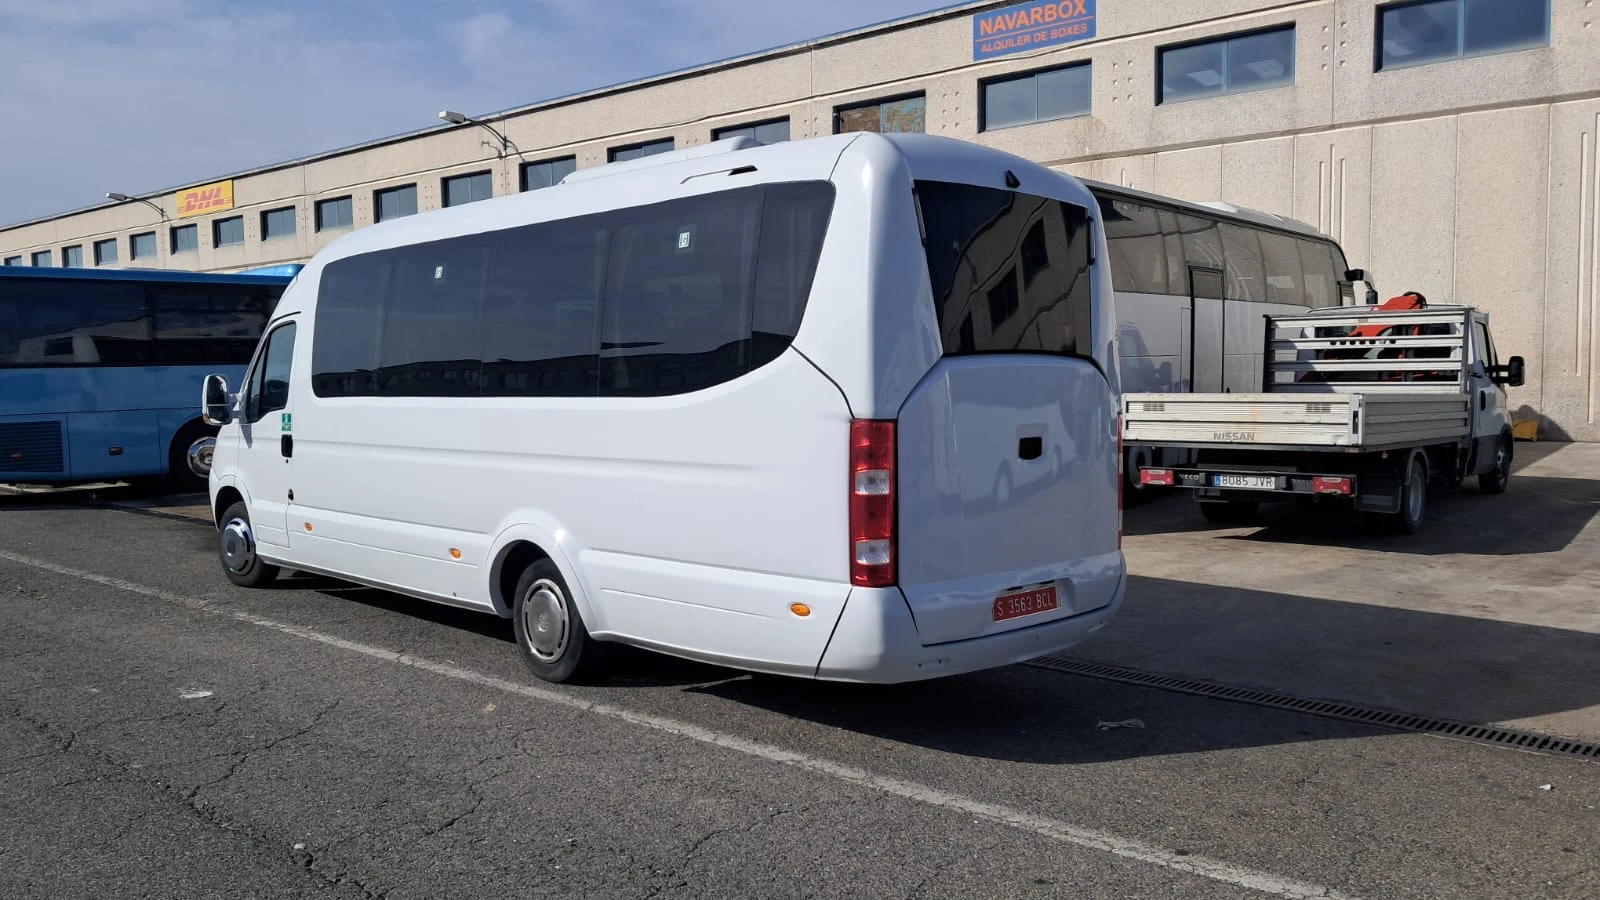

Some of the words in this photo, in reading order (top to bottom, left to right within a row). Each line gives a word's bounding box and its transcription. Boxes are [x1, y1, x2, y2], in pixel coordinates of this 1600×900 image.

[980, 0, 1087, 35] NAVARBOX
[981, 34, 1031, 53] ALQUILER
[1034, 31, 1049, 43] DE
[1051, 23, 1088, 39] BOXES
[184, 186, 225, 212] DHL
[1213, 431, 1255, 441] NISSAN
[1222, 475, 1249, 486] 8085
[1253, 477, 1273, 487] JVR
[997, 601, 1004, 617] S
[1008, 595, 1033, 614] 3563
[1036, 591, 1053, 609] BCL
